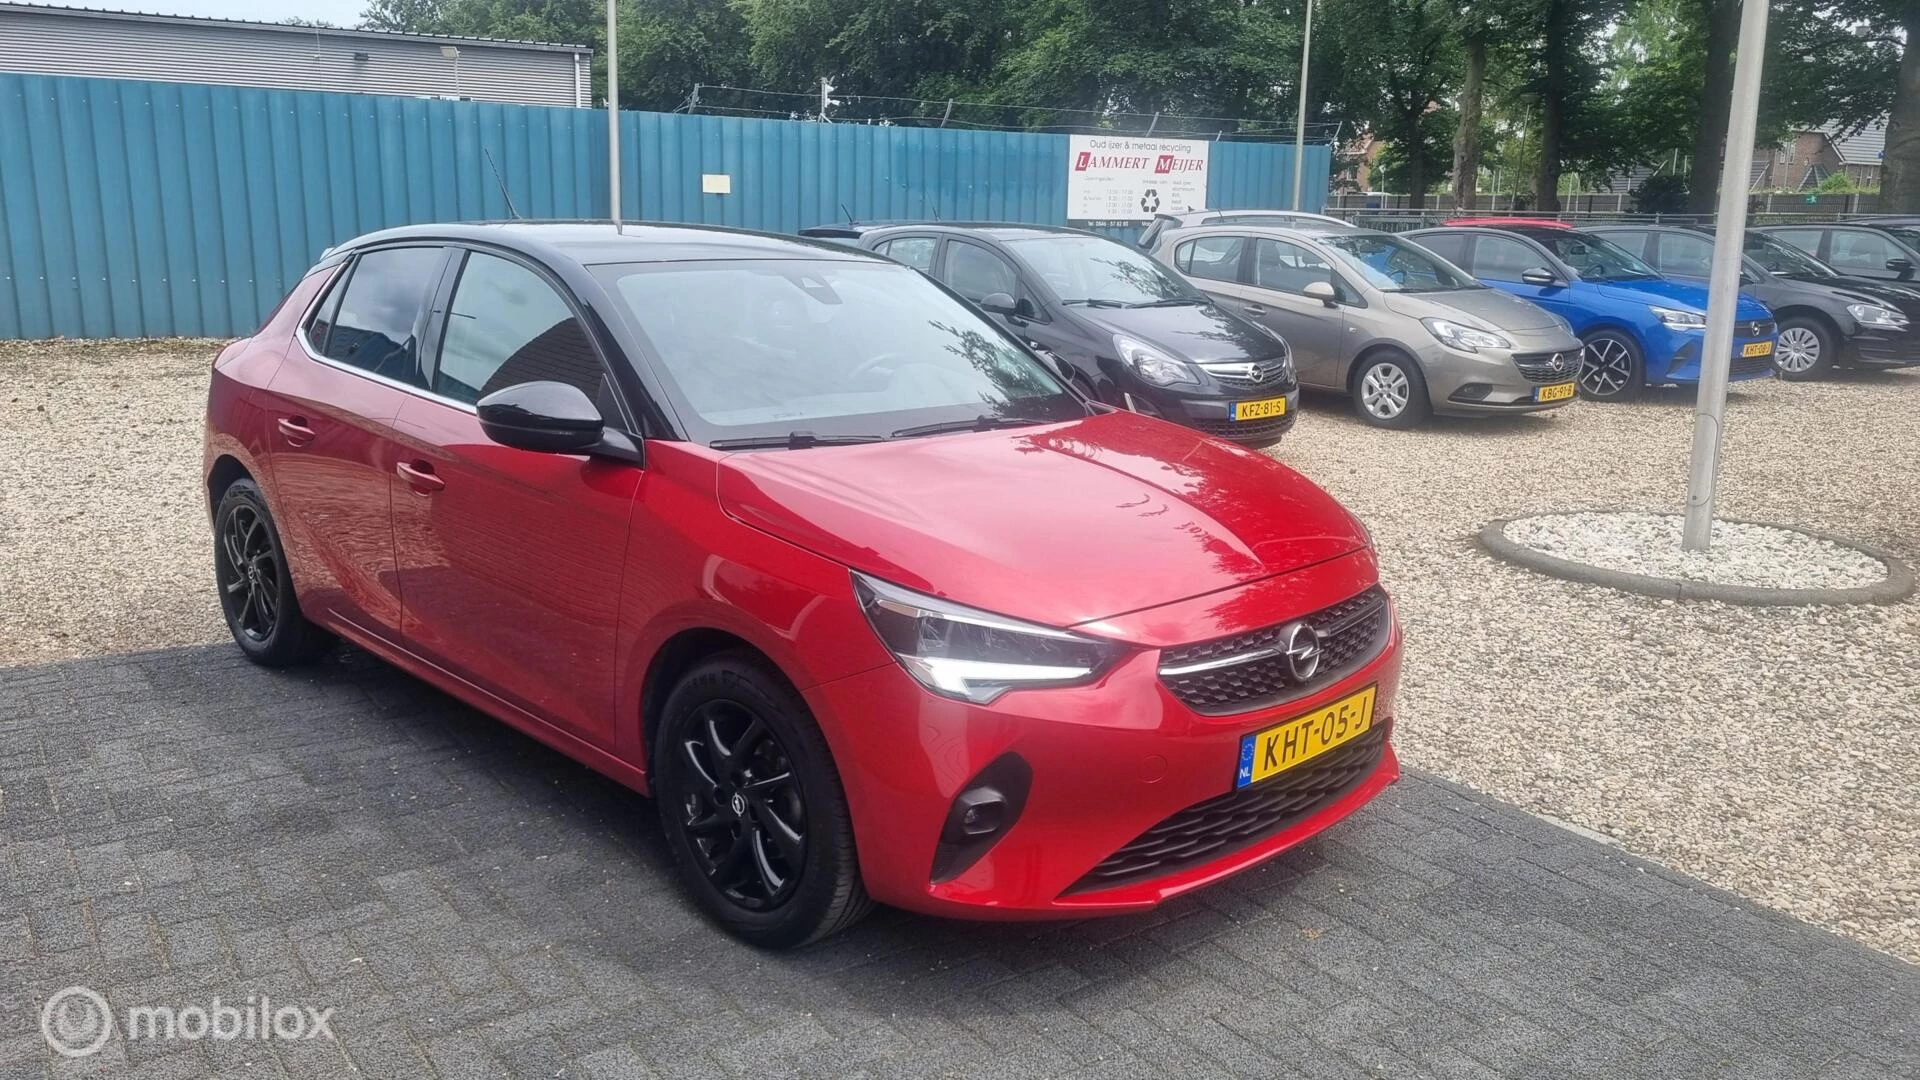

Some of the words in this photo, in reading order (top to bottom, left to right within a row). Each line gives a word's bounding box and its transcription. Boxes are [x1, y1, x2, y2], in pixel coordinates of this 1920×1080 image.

[1089, 139, 1107, 149] Oud
[1108, 141, 1123, 151] ijzer
[1124, 141, 1130, 150] &
[1132, 142, 1157, 151] metaal
[1159, 143, 1192, 154] recycling
[1077, 154, 1150, 170] LAMMERT
[1156, 157, 1204, 173] MEIJER
[1542, 384, 1573, 400] KBG-91-B
[1242, 401, 1281, 417] KFZ-81-S
[1263, 696, 1367, 771] KHT-05-J
[1239, 767, 1251, 779] NL
